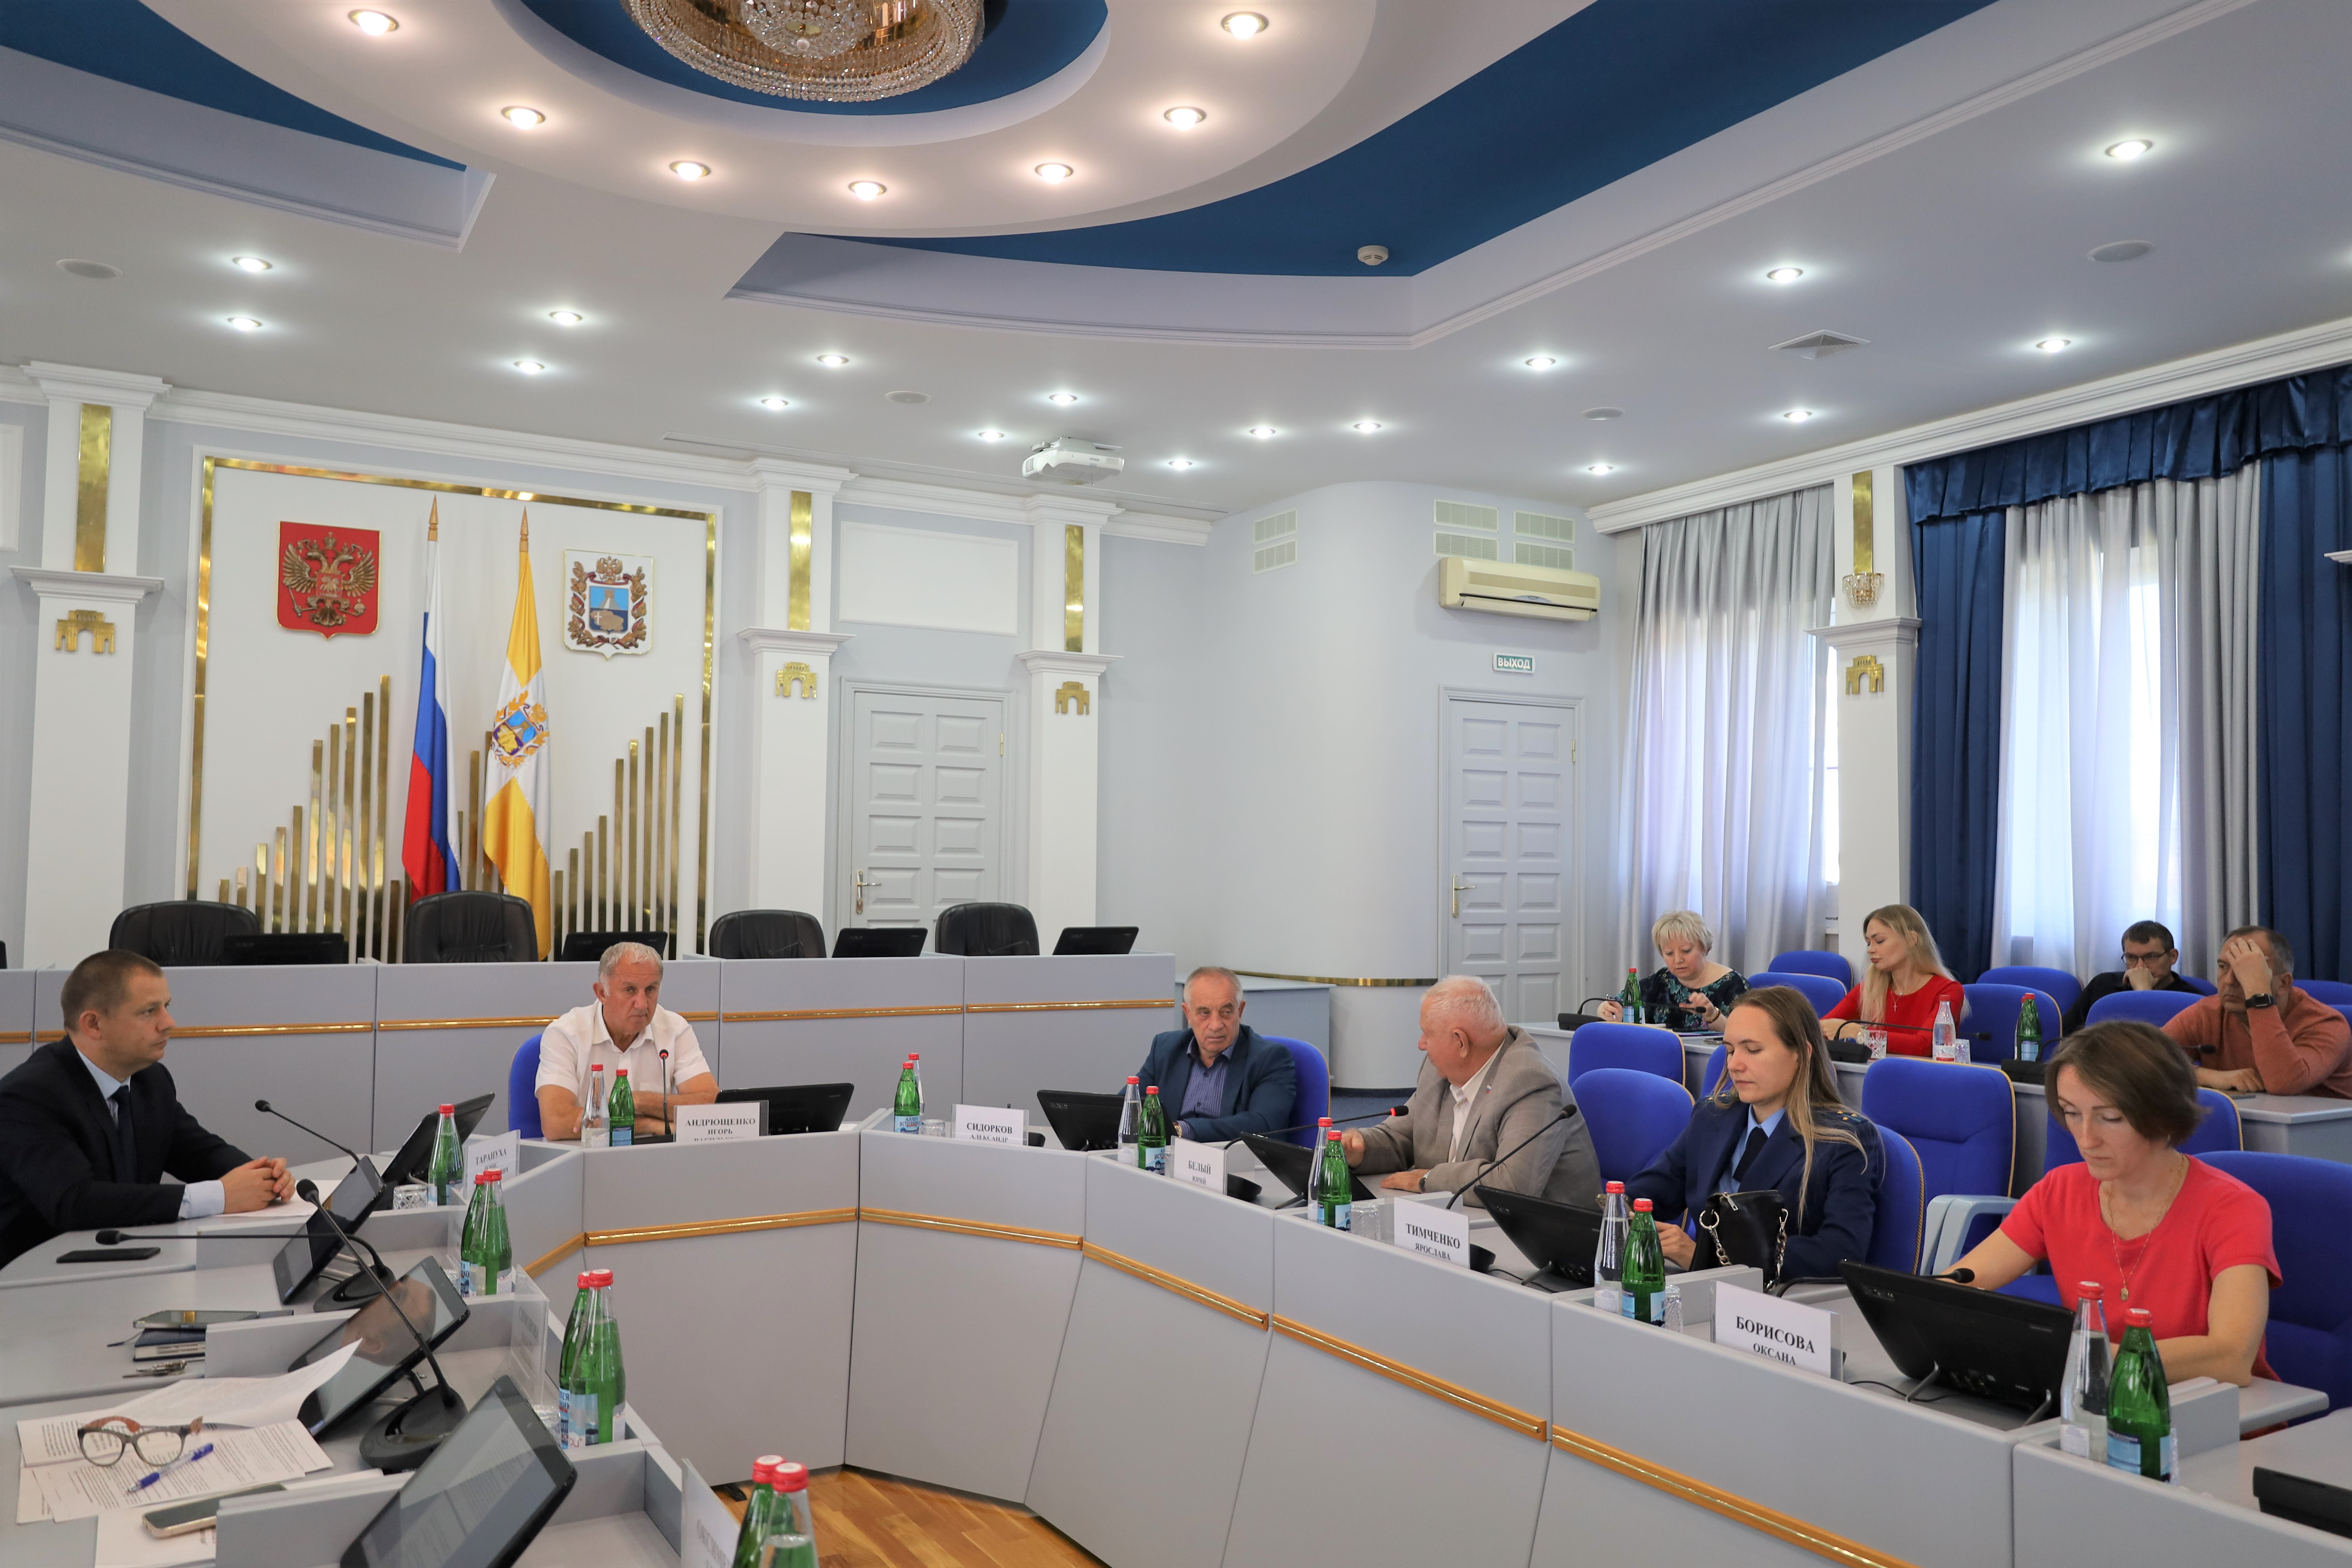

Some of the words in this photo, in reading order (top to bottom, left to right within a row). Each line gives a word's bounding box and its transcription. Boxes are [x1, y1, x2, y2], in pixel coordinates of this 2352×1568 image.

[1498, 657, 1530, 669] ВЫХОД
[685, 1118, 755, 1127] АНДРЮЩЕНКО
[967, 1122, 1012, 1134] СИДОРКОВ
[971, 1134, 1008, 1142] АЛЕКСАНДР
[476, 1148, 507, 1165] ТАРАНУХА
[1188, 1160, 1211, 1174] БЕЛЫЙ
[1192, 1175, 1206, 1185] ЮРИЙ
[1406, 1223, 1460, 1249] ТИМЧЕНКО
[1415, 1243, 1451, 1261] ЯРОСЛАВА
[1736, 1316, 1815, 1354] БОРИСОВА
[1753, 1343, 1796, 1366] ОКСАНА
